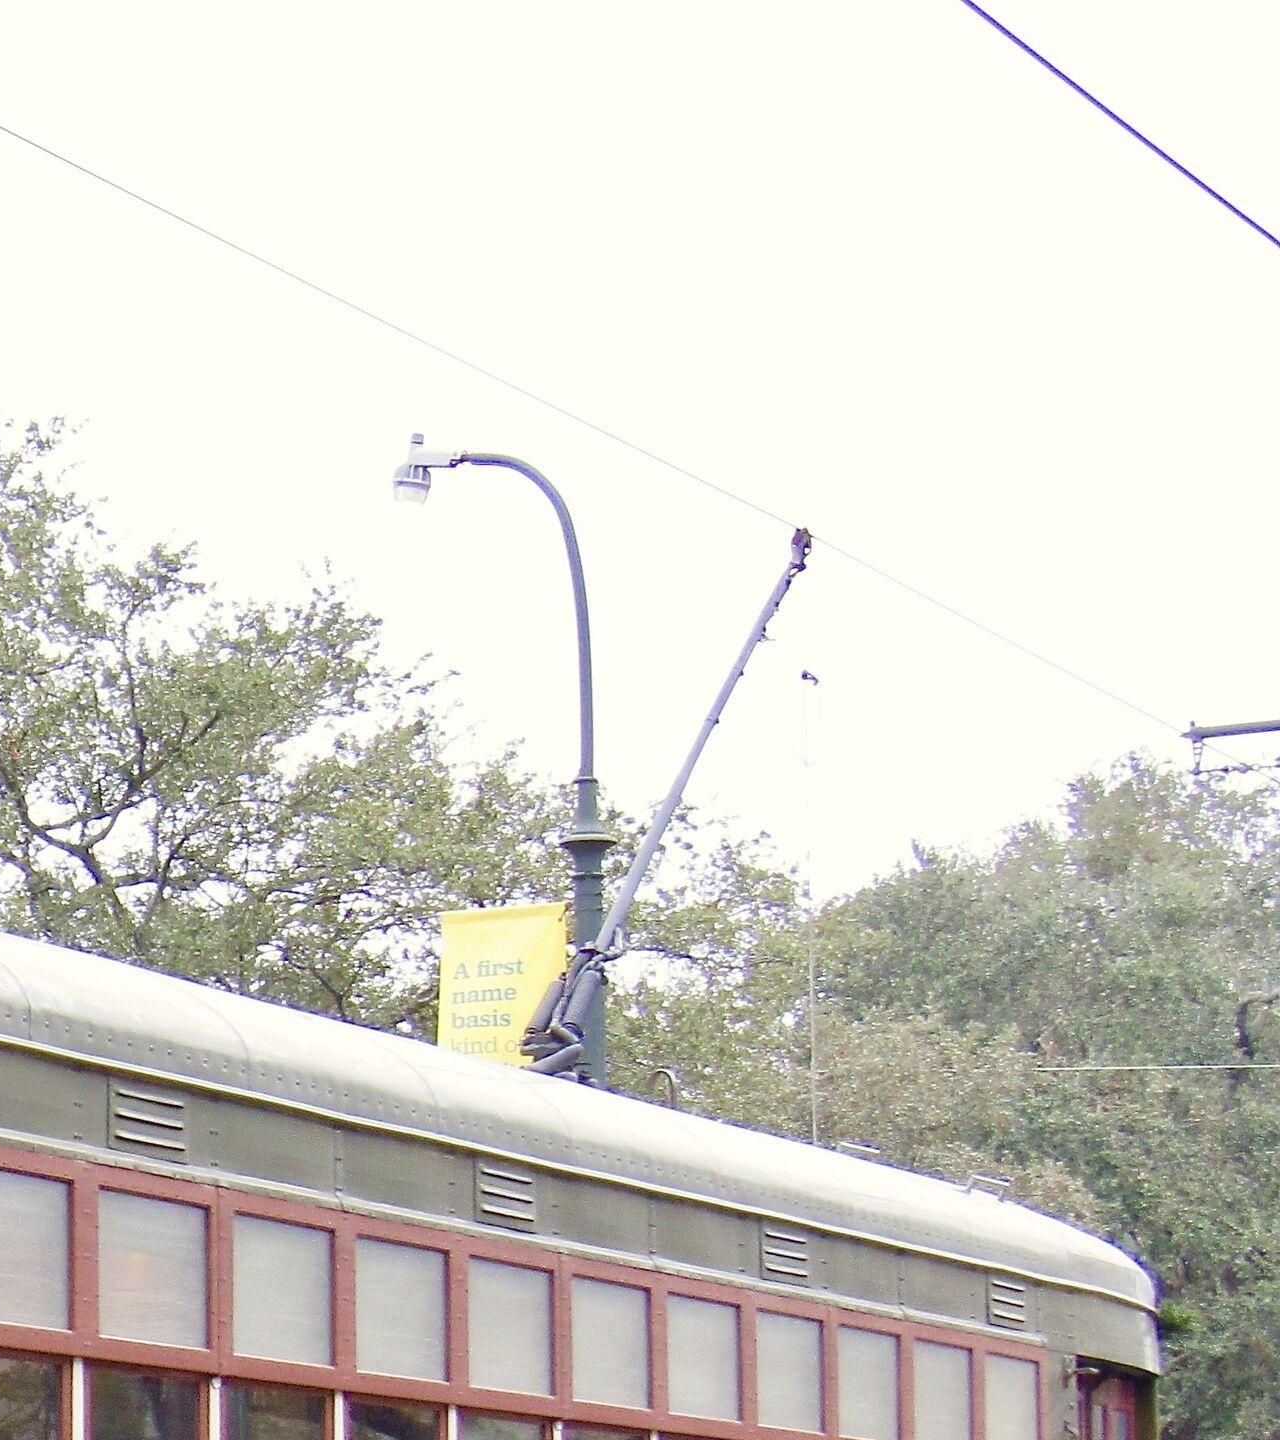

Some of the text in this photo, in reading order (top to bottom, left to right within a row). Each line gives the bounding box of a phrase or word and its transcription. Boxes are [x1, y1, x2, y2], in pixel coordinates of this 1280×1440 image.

[453, 959, 524, 979] A first
[451, 987, 517, 1004] name
[451, 1008, 512, 1029] basis
[450, 1036, 498, 1055] kind
